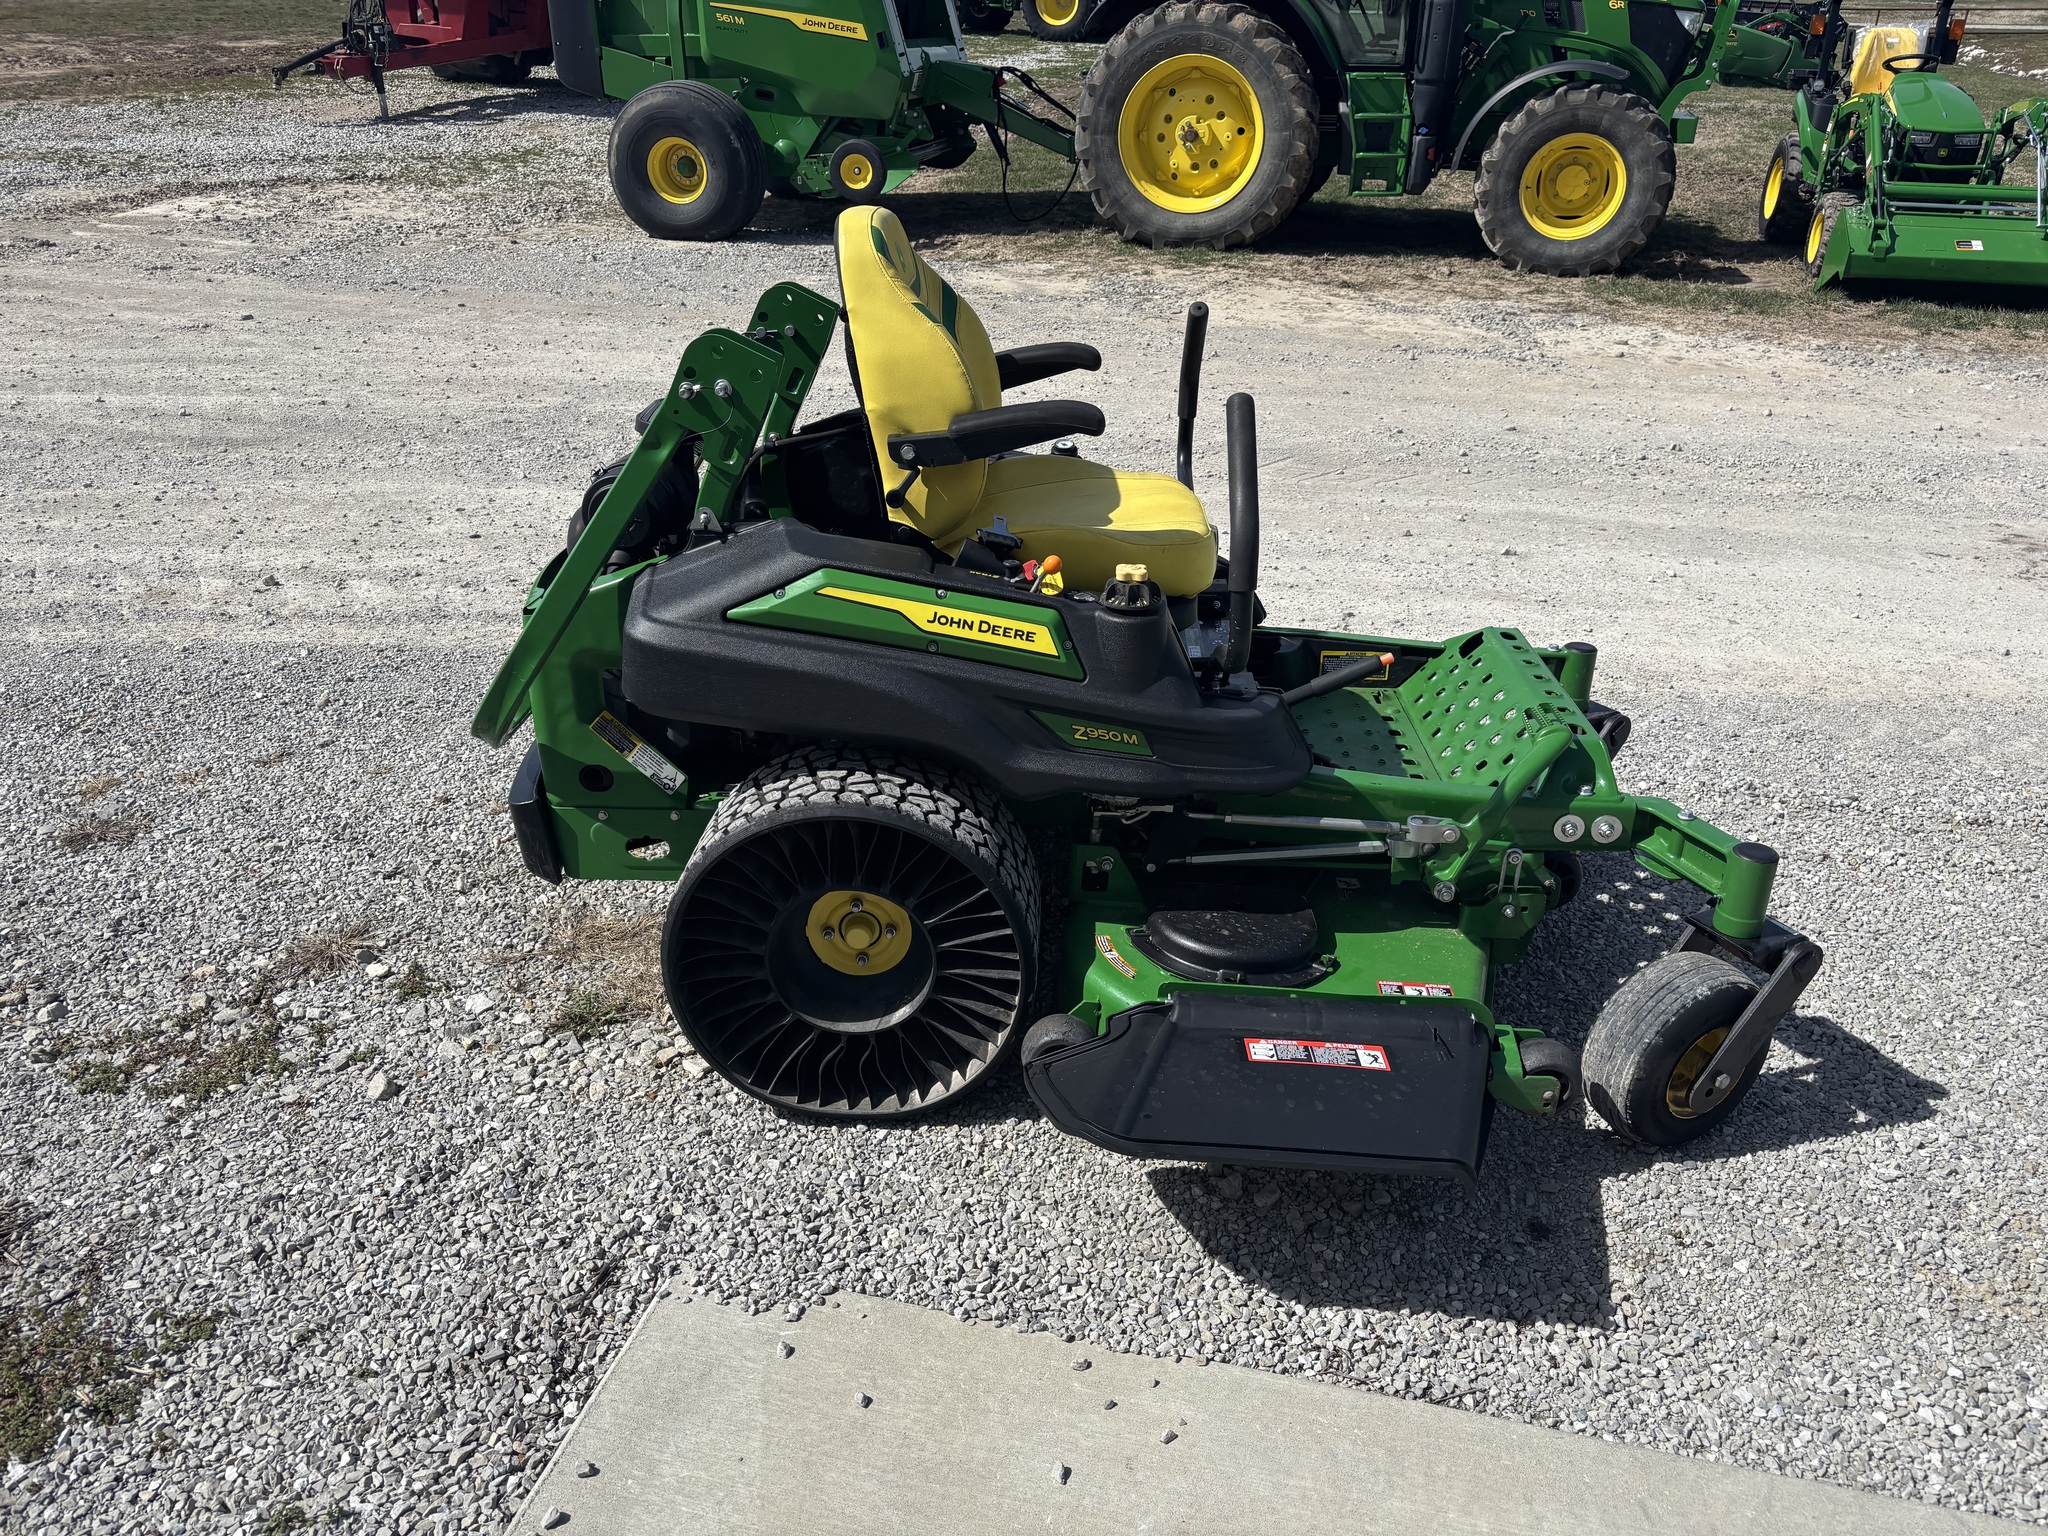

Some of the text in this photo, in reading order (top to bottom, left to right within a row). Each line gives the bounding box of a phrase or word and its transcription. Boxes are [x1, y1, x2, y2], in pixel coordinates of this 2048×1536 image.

[1608, 0, 1625, 9] 6R
[802, 17, 858, 34] JOHN DEERE
[926, 611, 1037, 643] JOHN DEERE
